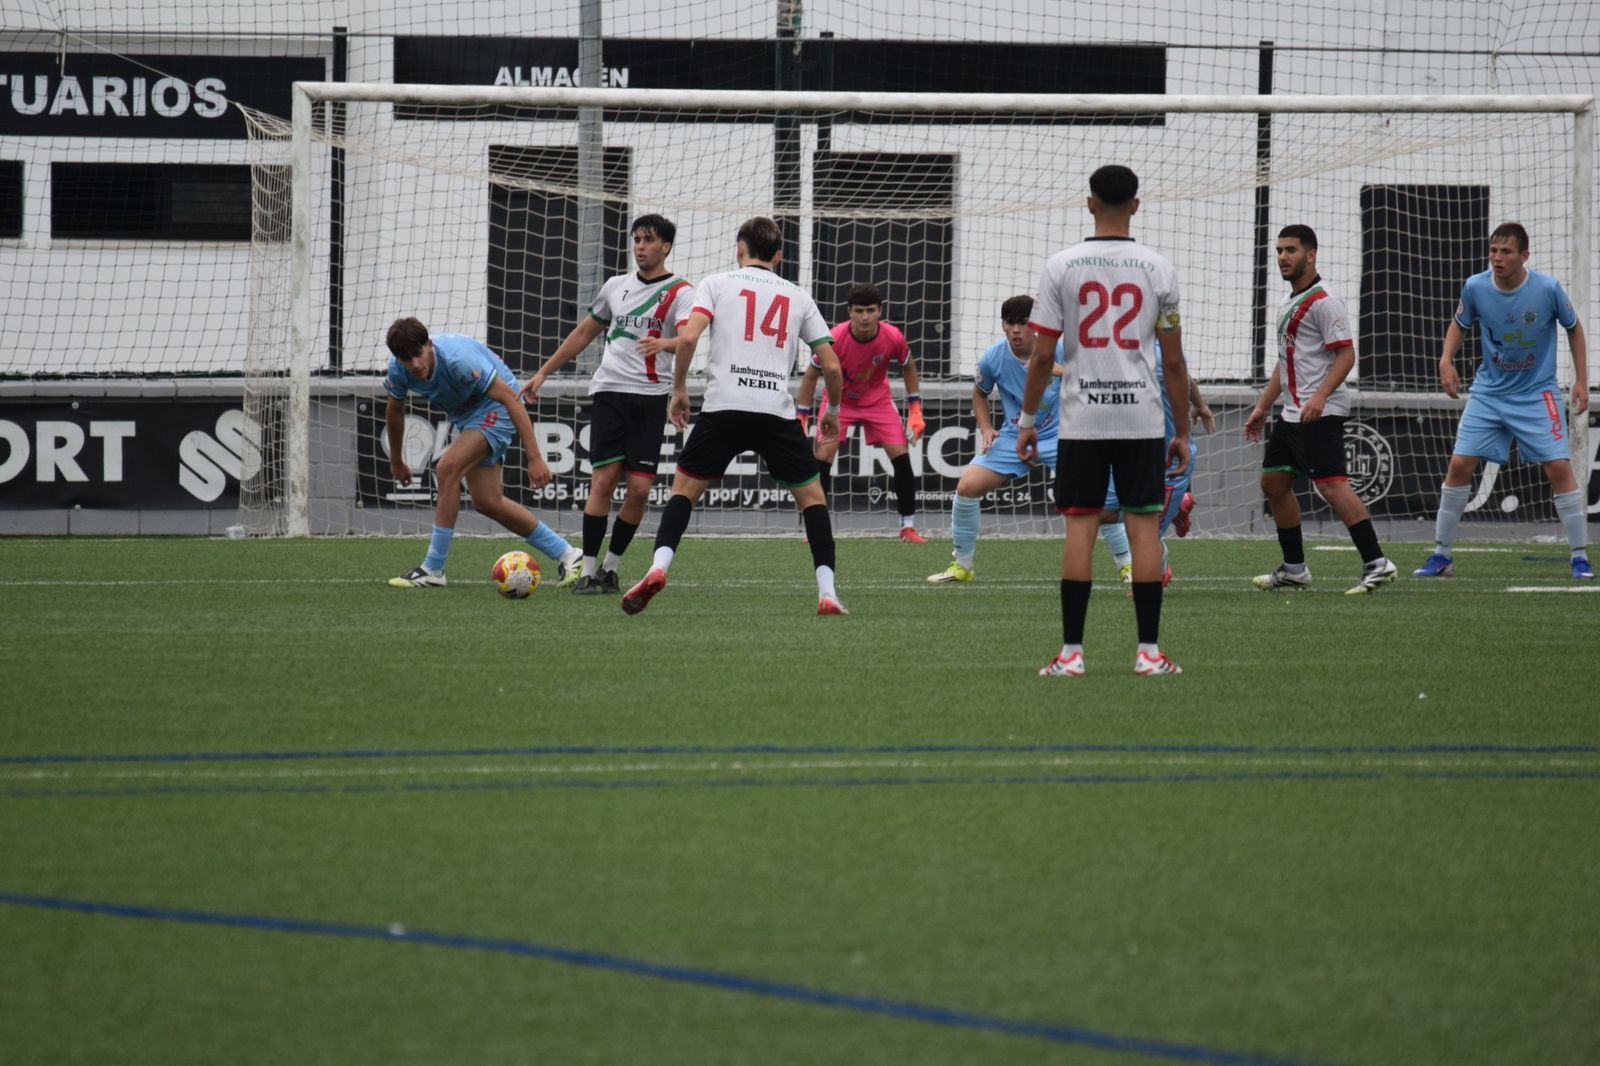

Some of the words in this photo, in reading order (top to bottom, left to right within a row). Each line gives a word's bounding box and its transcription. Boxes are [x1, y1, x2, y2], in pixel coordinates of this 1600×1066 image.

[494, 66, 629, 87] ALMAN
[0, 74, 228, 118] UARIOS
[1066, 256, 1118, 270] SPORTING
[621, 290, 629, 301] 7
[616, 315, 663, 330] CEUTA
[739, 288, 790, 348] 14
[1079, 281, 1143, 350] 22
[738, 377, 780, 391] NEBIL
[1088, 393, 1139, 405] NEBIL
[709, 488, 738, 505] por
[743, 489, 754, 505] y
